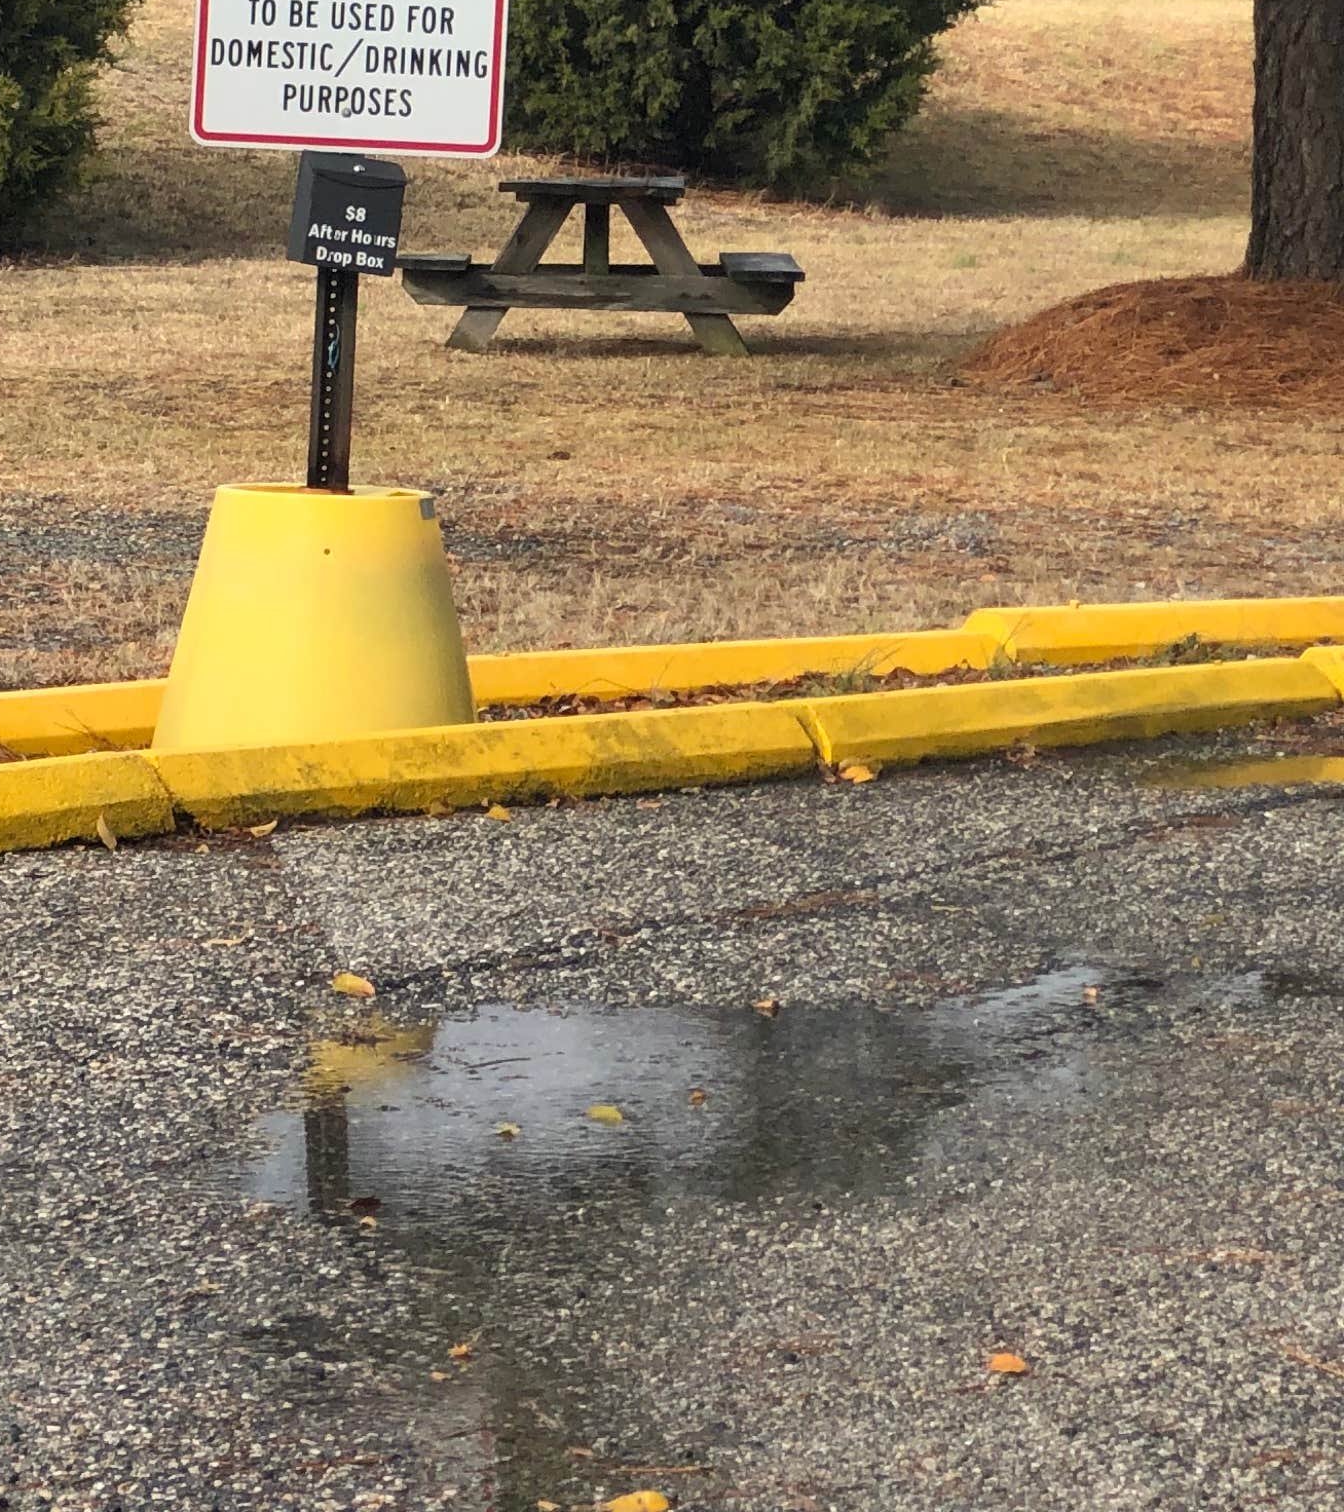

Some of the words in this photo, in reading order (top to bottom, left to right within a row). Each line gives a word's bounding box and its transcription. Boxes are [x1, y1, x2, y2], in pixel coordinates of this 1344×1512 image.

[289, 0, 319, 28] BE
[331, 2, 395, 33] USED
[407, 6, 455, 35] FOR
[283, 83, 413, 117] PURPOSES
[308, 223, 348, 242] After
[351, 229, 396, 249] Hours
[316, 246, 352, 267] Drop
[356, 252, 384, 269] Box
